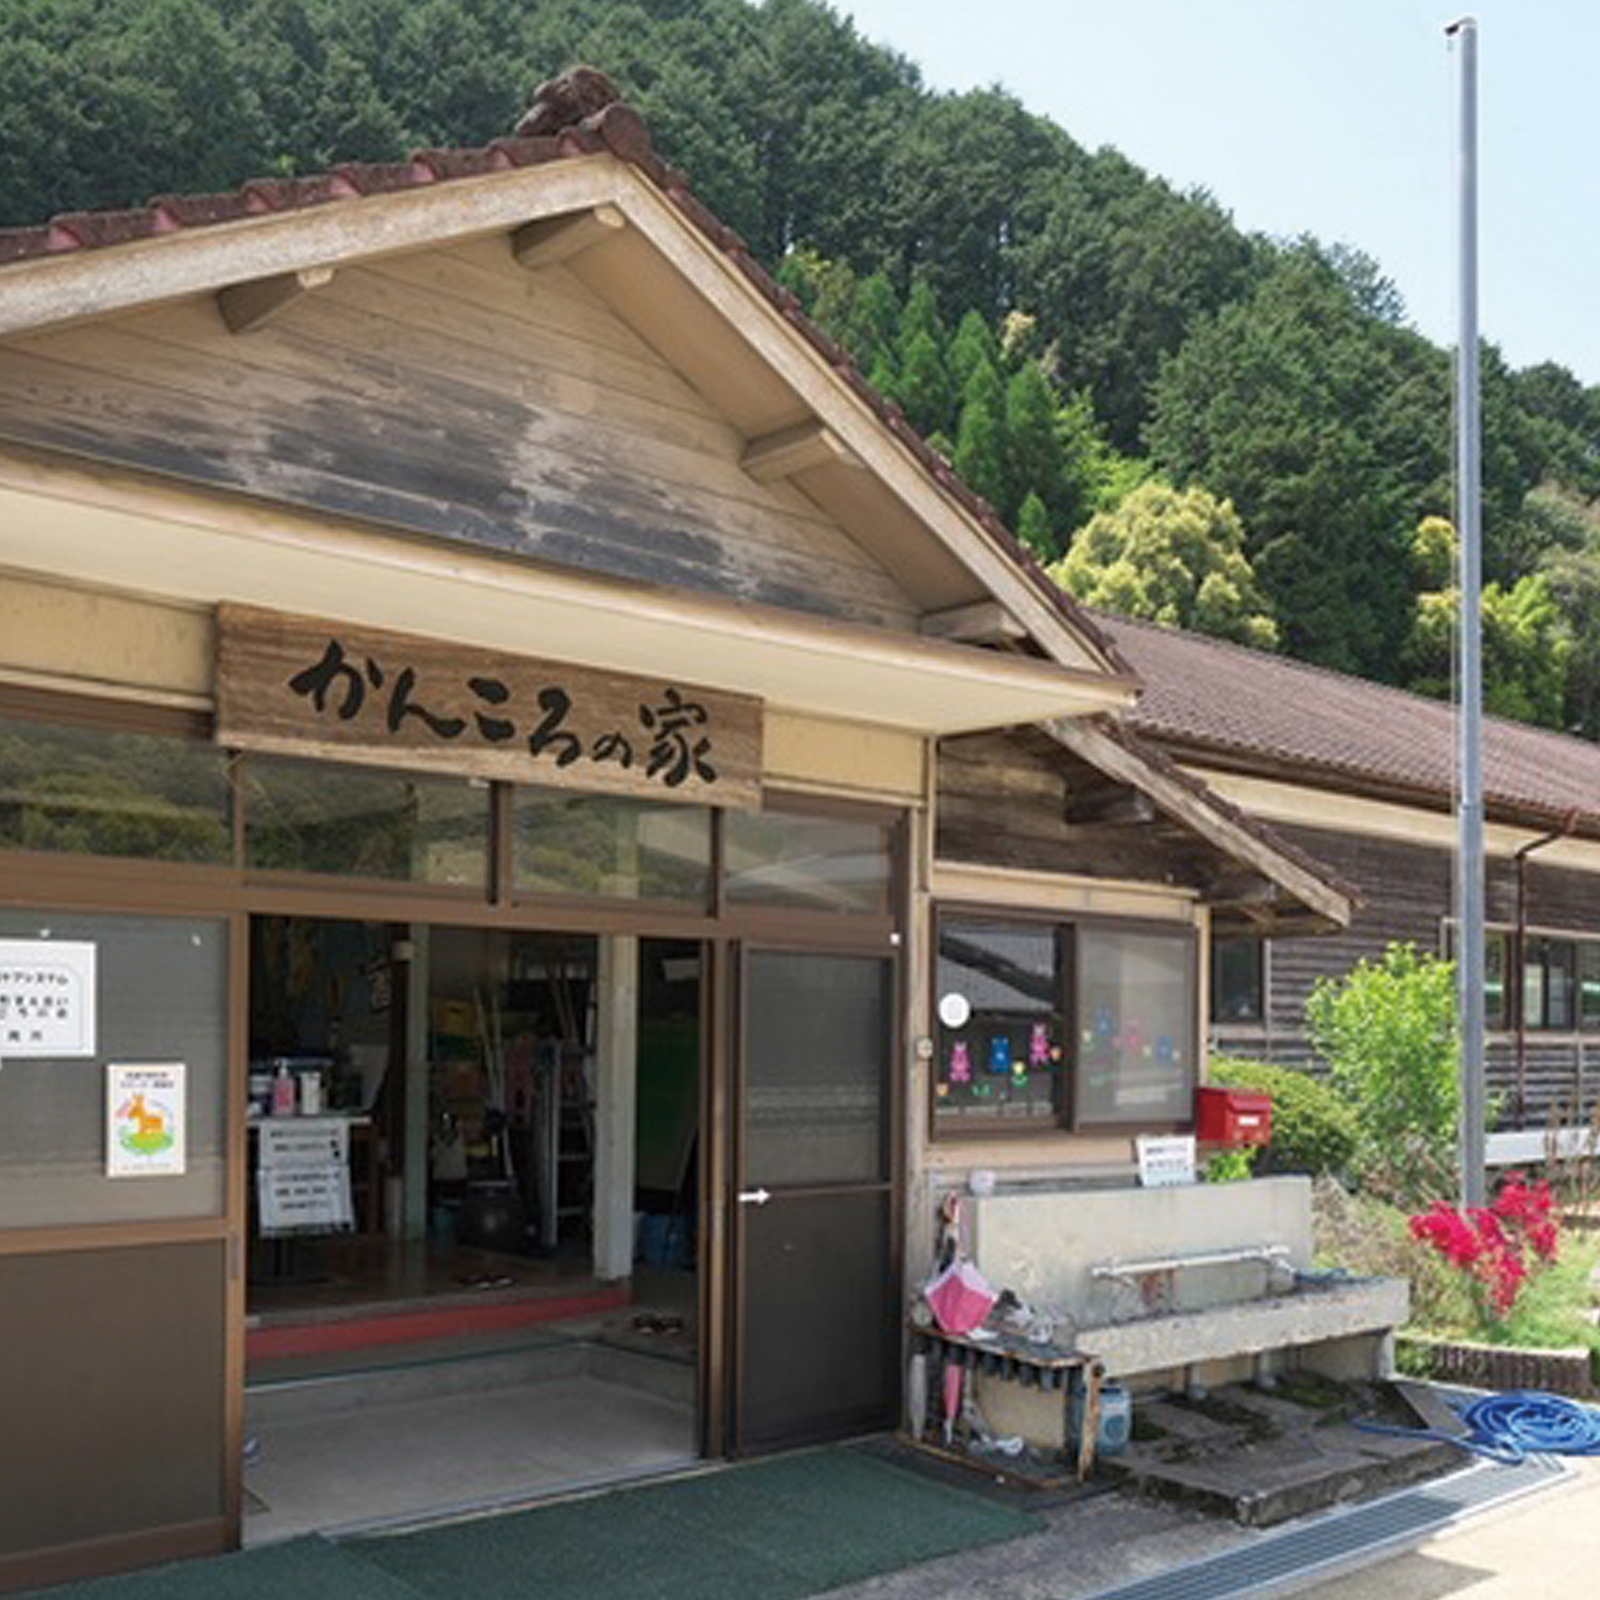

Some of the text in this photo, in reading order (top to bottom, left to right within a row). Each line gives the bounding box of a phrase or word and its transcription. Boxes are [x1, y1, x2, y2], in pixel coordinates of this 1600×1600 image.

[288, 638, 717, 788] かんころの家
